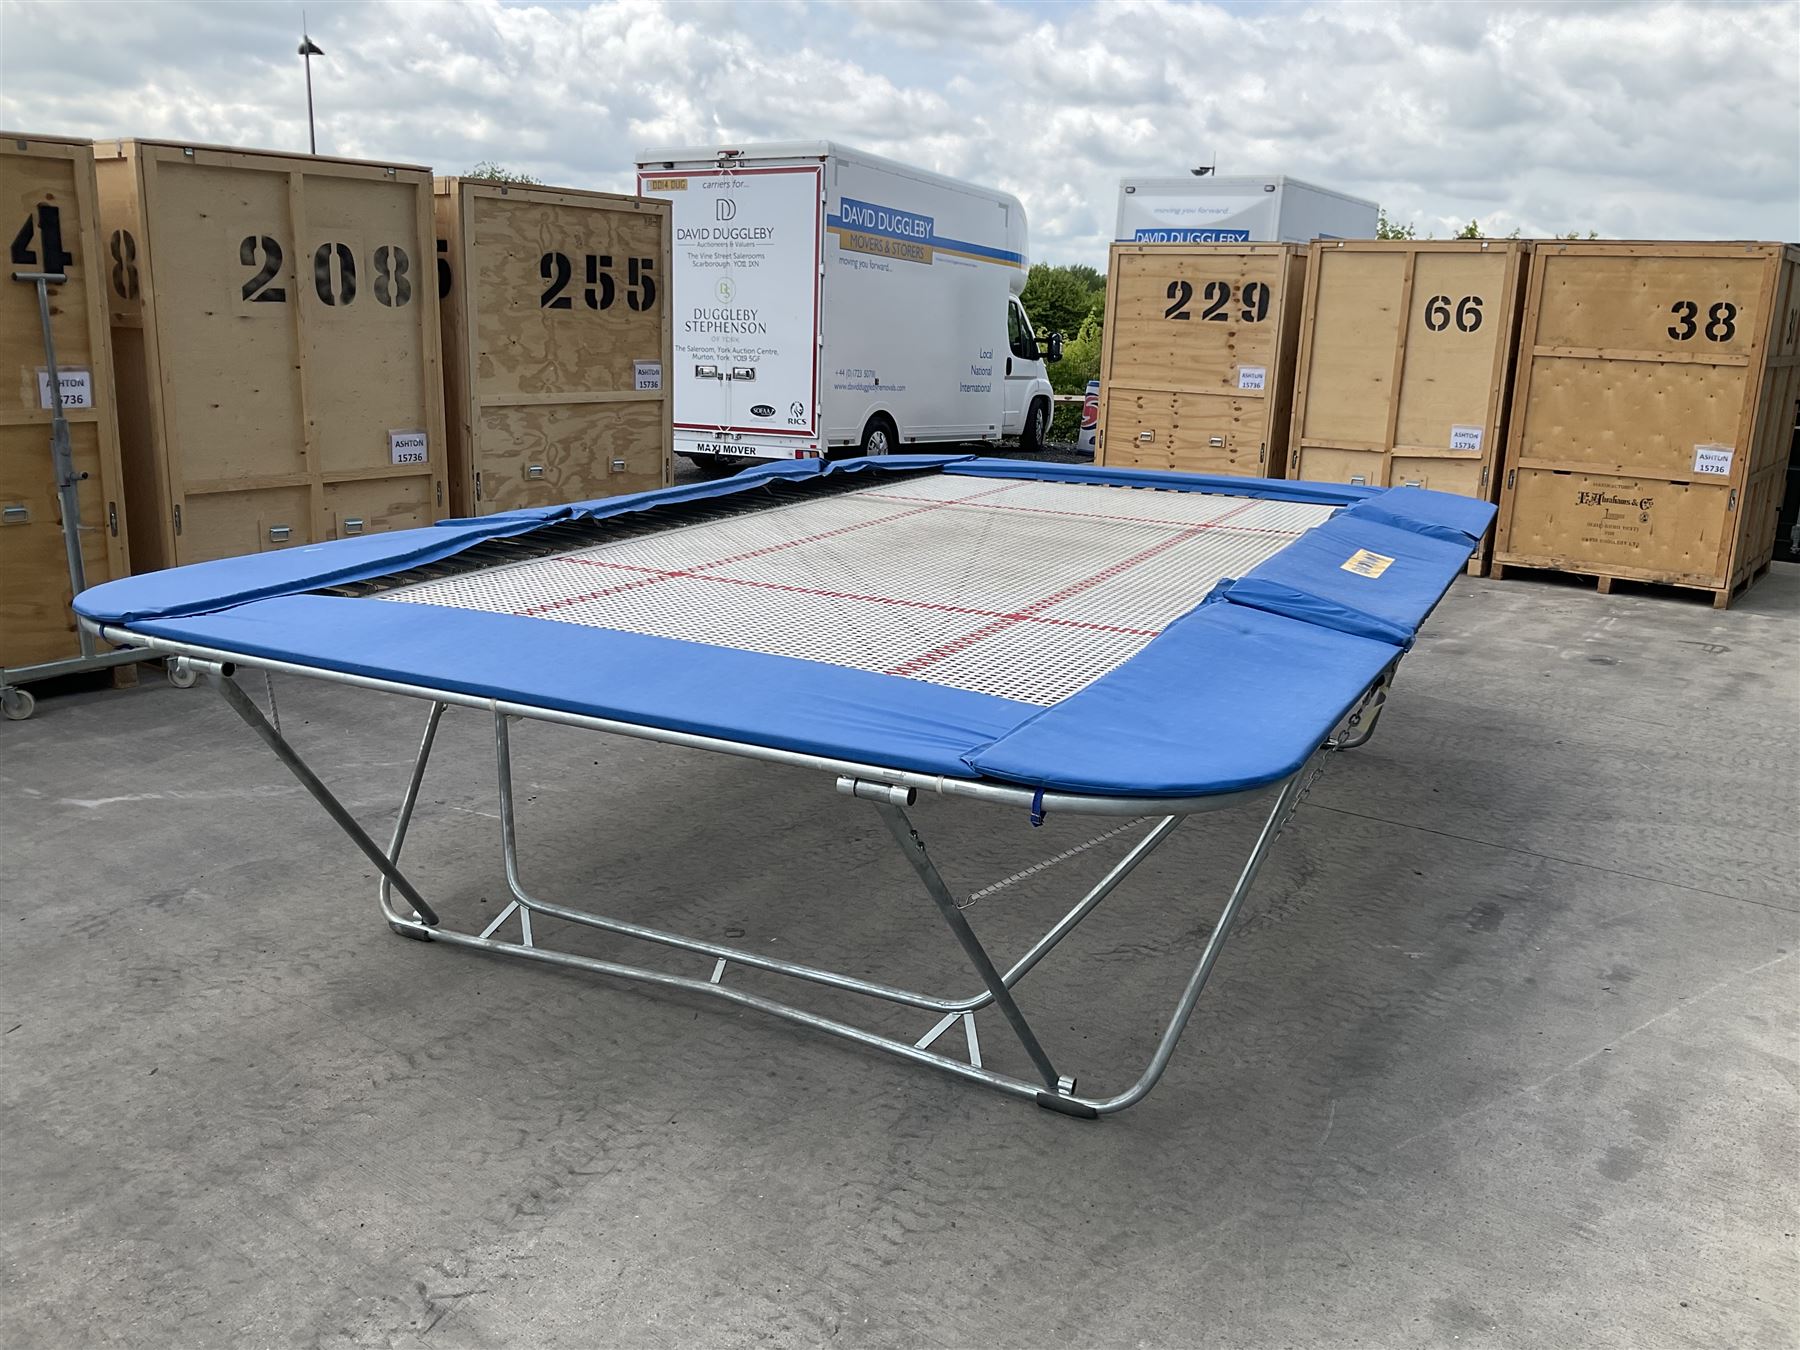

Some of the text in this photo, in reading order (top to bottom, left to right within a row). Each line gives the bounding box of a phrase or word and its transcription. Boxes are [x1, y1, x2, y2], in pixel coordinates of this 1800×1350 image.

[702, 180, 731, 189] carriers
[1153, 207, 1180, 215] moving
[842, 204, 932, 239] DAVID DUGGLEBY
[11, 203, 73, 275] 4
[677, 227, 775, 240] DAVID DUGGLEBY
[1136, 232, 1168, 242] DAVID
[849, 234, 926, 260] MOVERS & STORERS
[692, 260, 731, 268] Scarborough
[838, 257, 859, 270] moving
[858, 261, 869, 269] you
[239, 235, 413, 308] 208
[540, 252, 657, 311] 255
[1164, 280, 1271, 322] 229
[693, 308, 758, 321] DUGGLEBY
[1424, 295, 1484, 333] 66
[1667, 301, 1737, 342] 38
[684, 321, 767, 334] STEPHENSON
[979, 349, 993, 358] Local
[970, 365, 992, 376] National
[639, 380, 659, 388] 15736
[959, 382, 992, 393] International
[395, 439, 424, 448] ASHTON
[697, 443, 756, 455] MAXI MOVER
[398, 453, 423, 462] 15736
[1699, 453, 1728, 462] ASHTON
[1700, 464, 1725, 473] 15736
[1631, 499, 1639, 507] &
